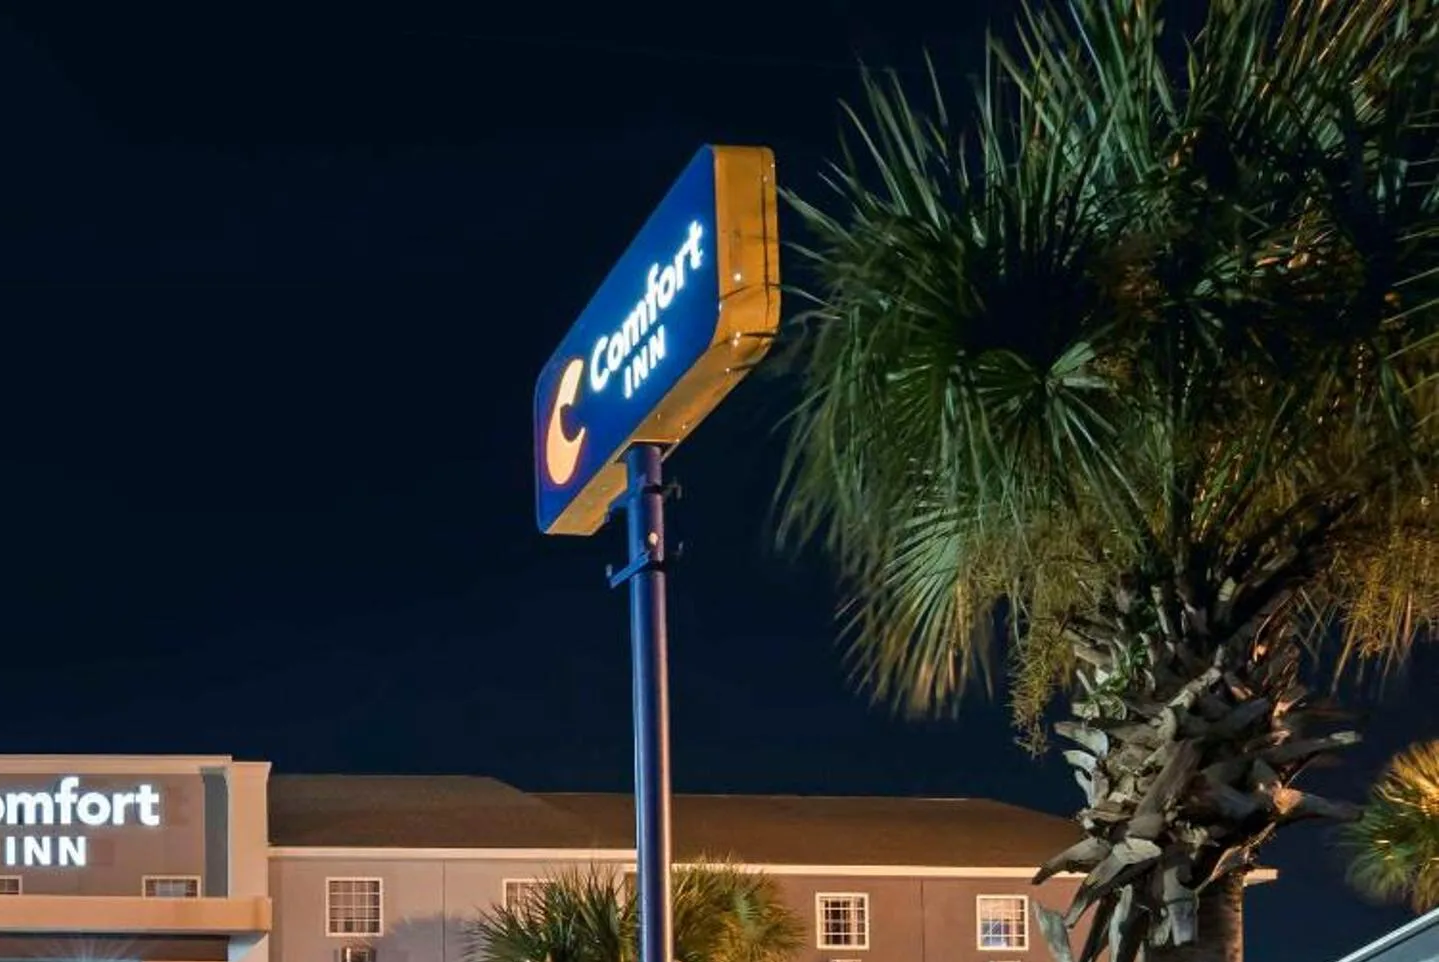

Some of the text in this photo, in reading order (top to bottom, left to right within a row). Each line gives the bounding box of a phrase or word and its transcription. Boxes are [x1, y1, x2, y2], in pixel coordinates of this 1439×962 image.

[589, 220, 704, 392] Comfort
[625, 326, 666, 399] INN
[6, 835, 86, 867] INN
